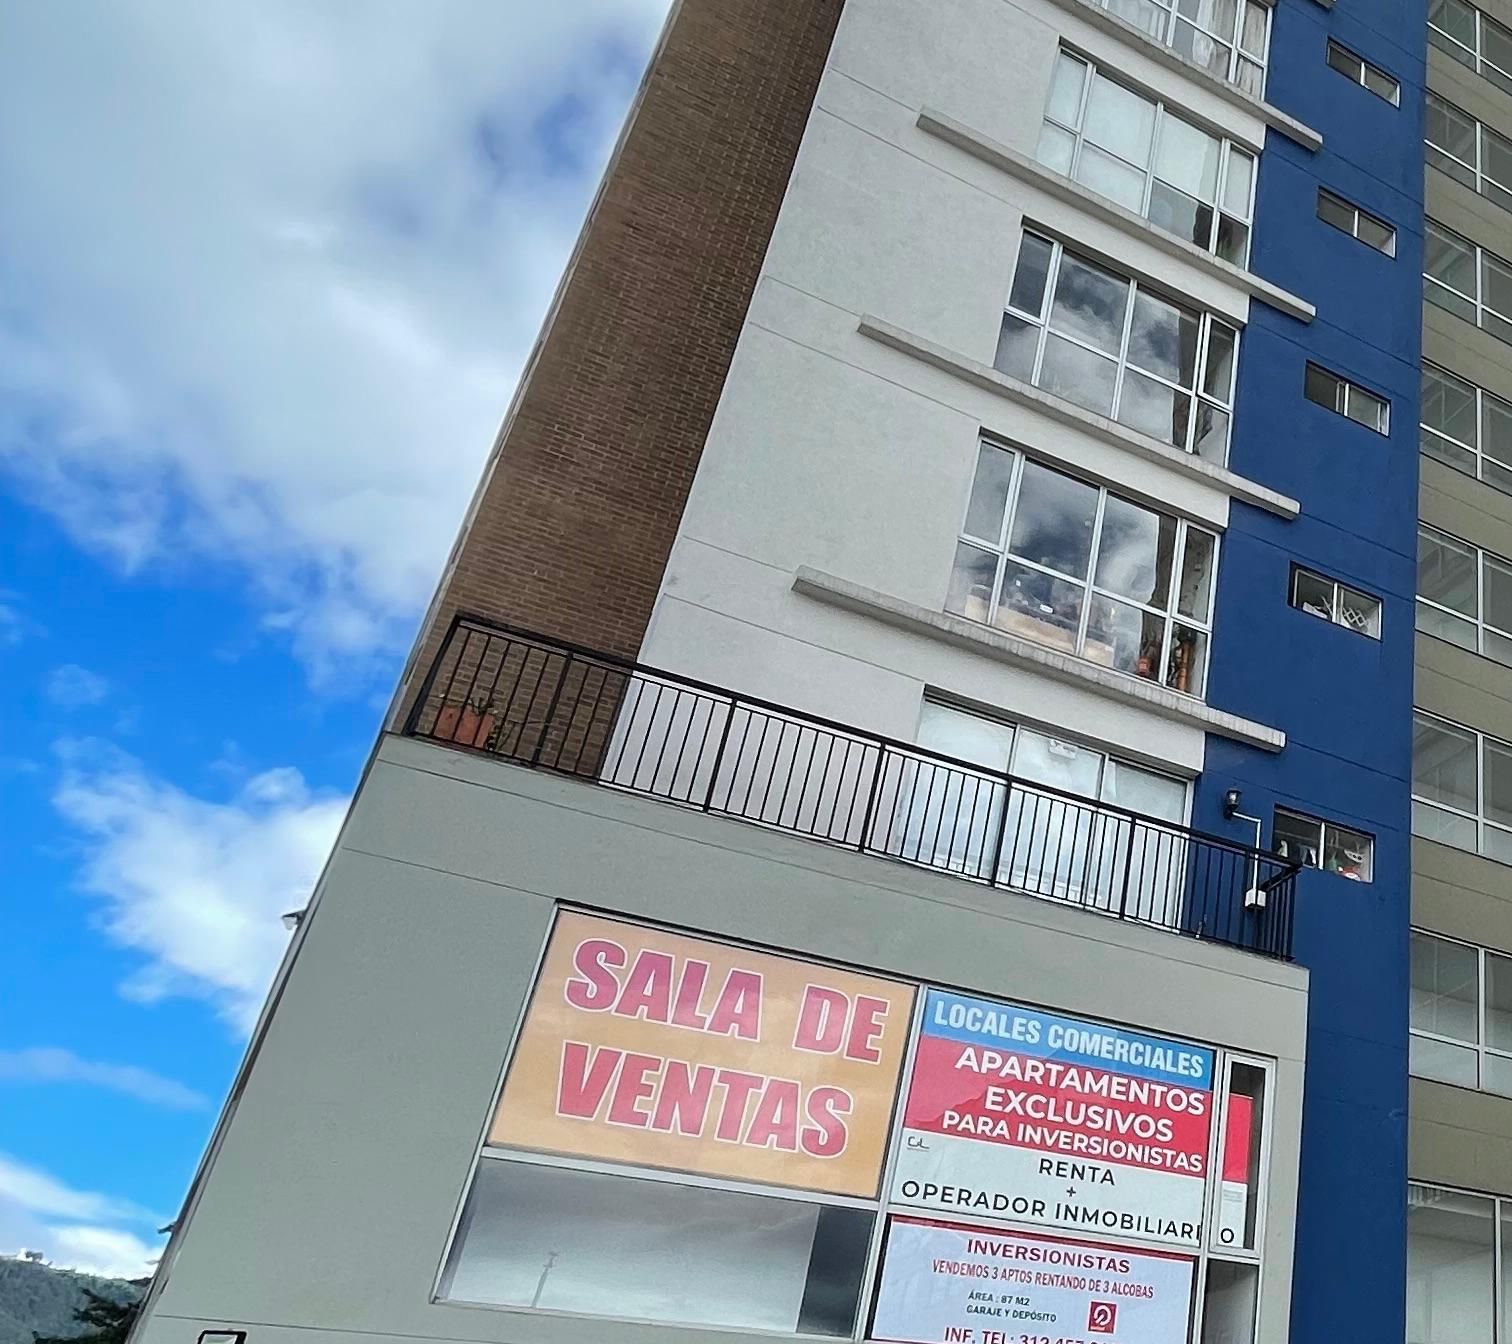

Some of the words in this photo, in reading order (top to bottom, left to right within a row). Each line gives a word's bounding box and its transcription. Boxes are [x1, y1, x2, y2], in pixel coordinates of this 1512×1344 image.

[565, 938, 763, 1042] SALA
[793, 984, 890, 1064] DE
[934, 1001, 1041, 1044] LOCALES
[1048, 1025, 1203, 1078] COMERCIALES
[556, 1041, 852, 1159] VENTAS
[954, 1047, 1205, 1115] APARTAMENTOS
[984, 1087, 1173, 1142] EXCLUSIVOS
[943, 1110, 1010, 1139] PARA
[1017, 1123, 1202, 1172] INVERSIONISTAS
[1038, 1158, 1115, 1186] RENTA
[901, 1181, 1047, 1217] OPERADOR
[967, 1238, 1130, 1274] INVERSIONISTAS
[932, 1259, 990, 1279] VENDEMOS
[991, 1267, 998, 1279] 3
[1000, 1268, 1033, 1284] APTOS
[1034, 1272, 1086, 1291] RENTANDO
[1088, 1280, 1101, 1292] DE
[1102, 1281, 1110, 1293] 3
[1111, 1284, 1154, 1299] ALCOBAS
[968, 1289, 994, 1302] ÁREA
[1001, 1296, 1013, 1305] 87
[1015, 1296, 1031, 1306] M2
[966, 1305, 1002, 1317] GARAJE
[1004, 1308, 1011, 1318] Y
[1012, 1309, 1057, 1323] DEPÓSITO
[944, 1326, 976, 1344] INF.
